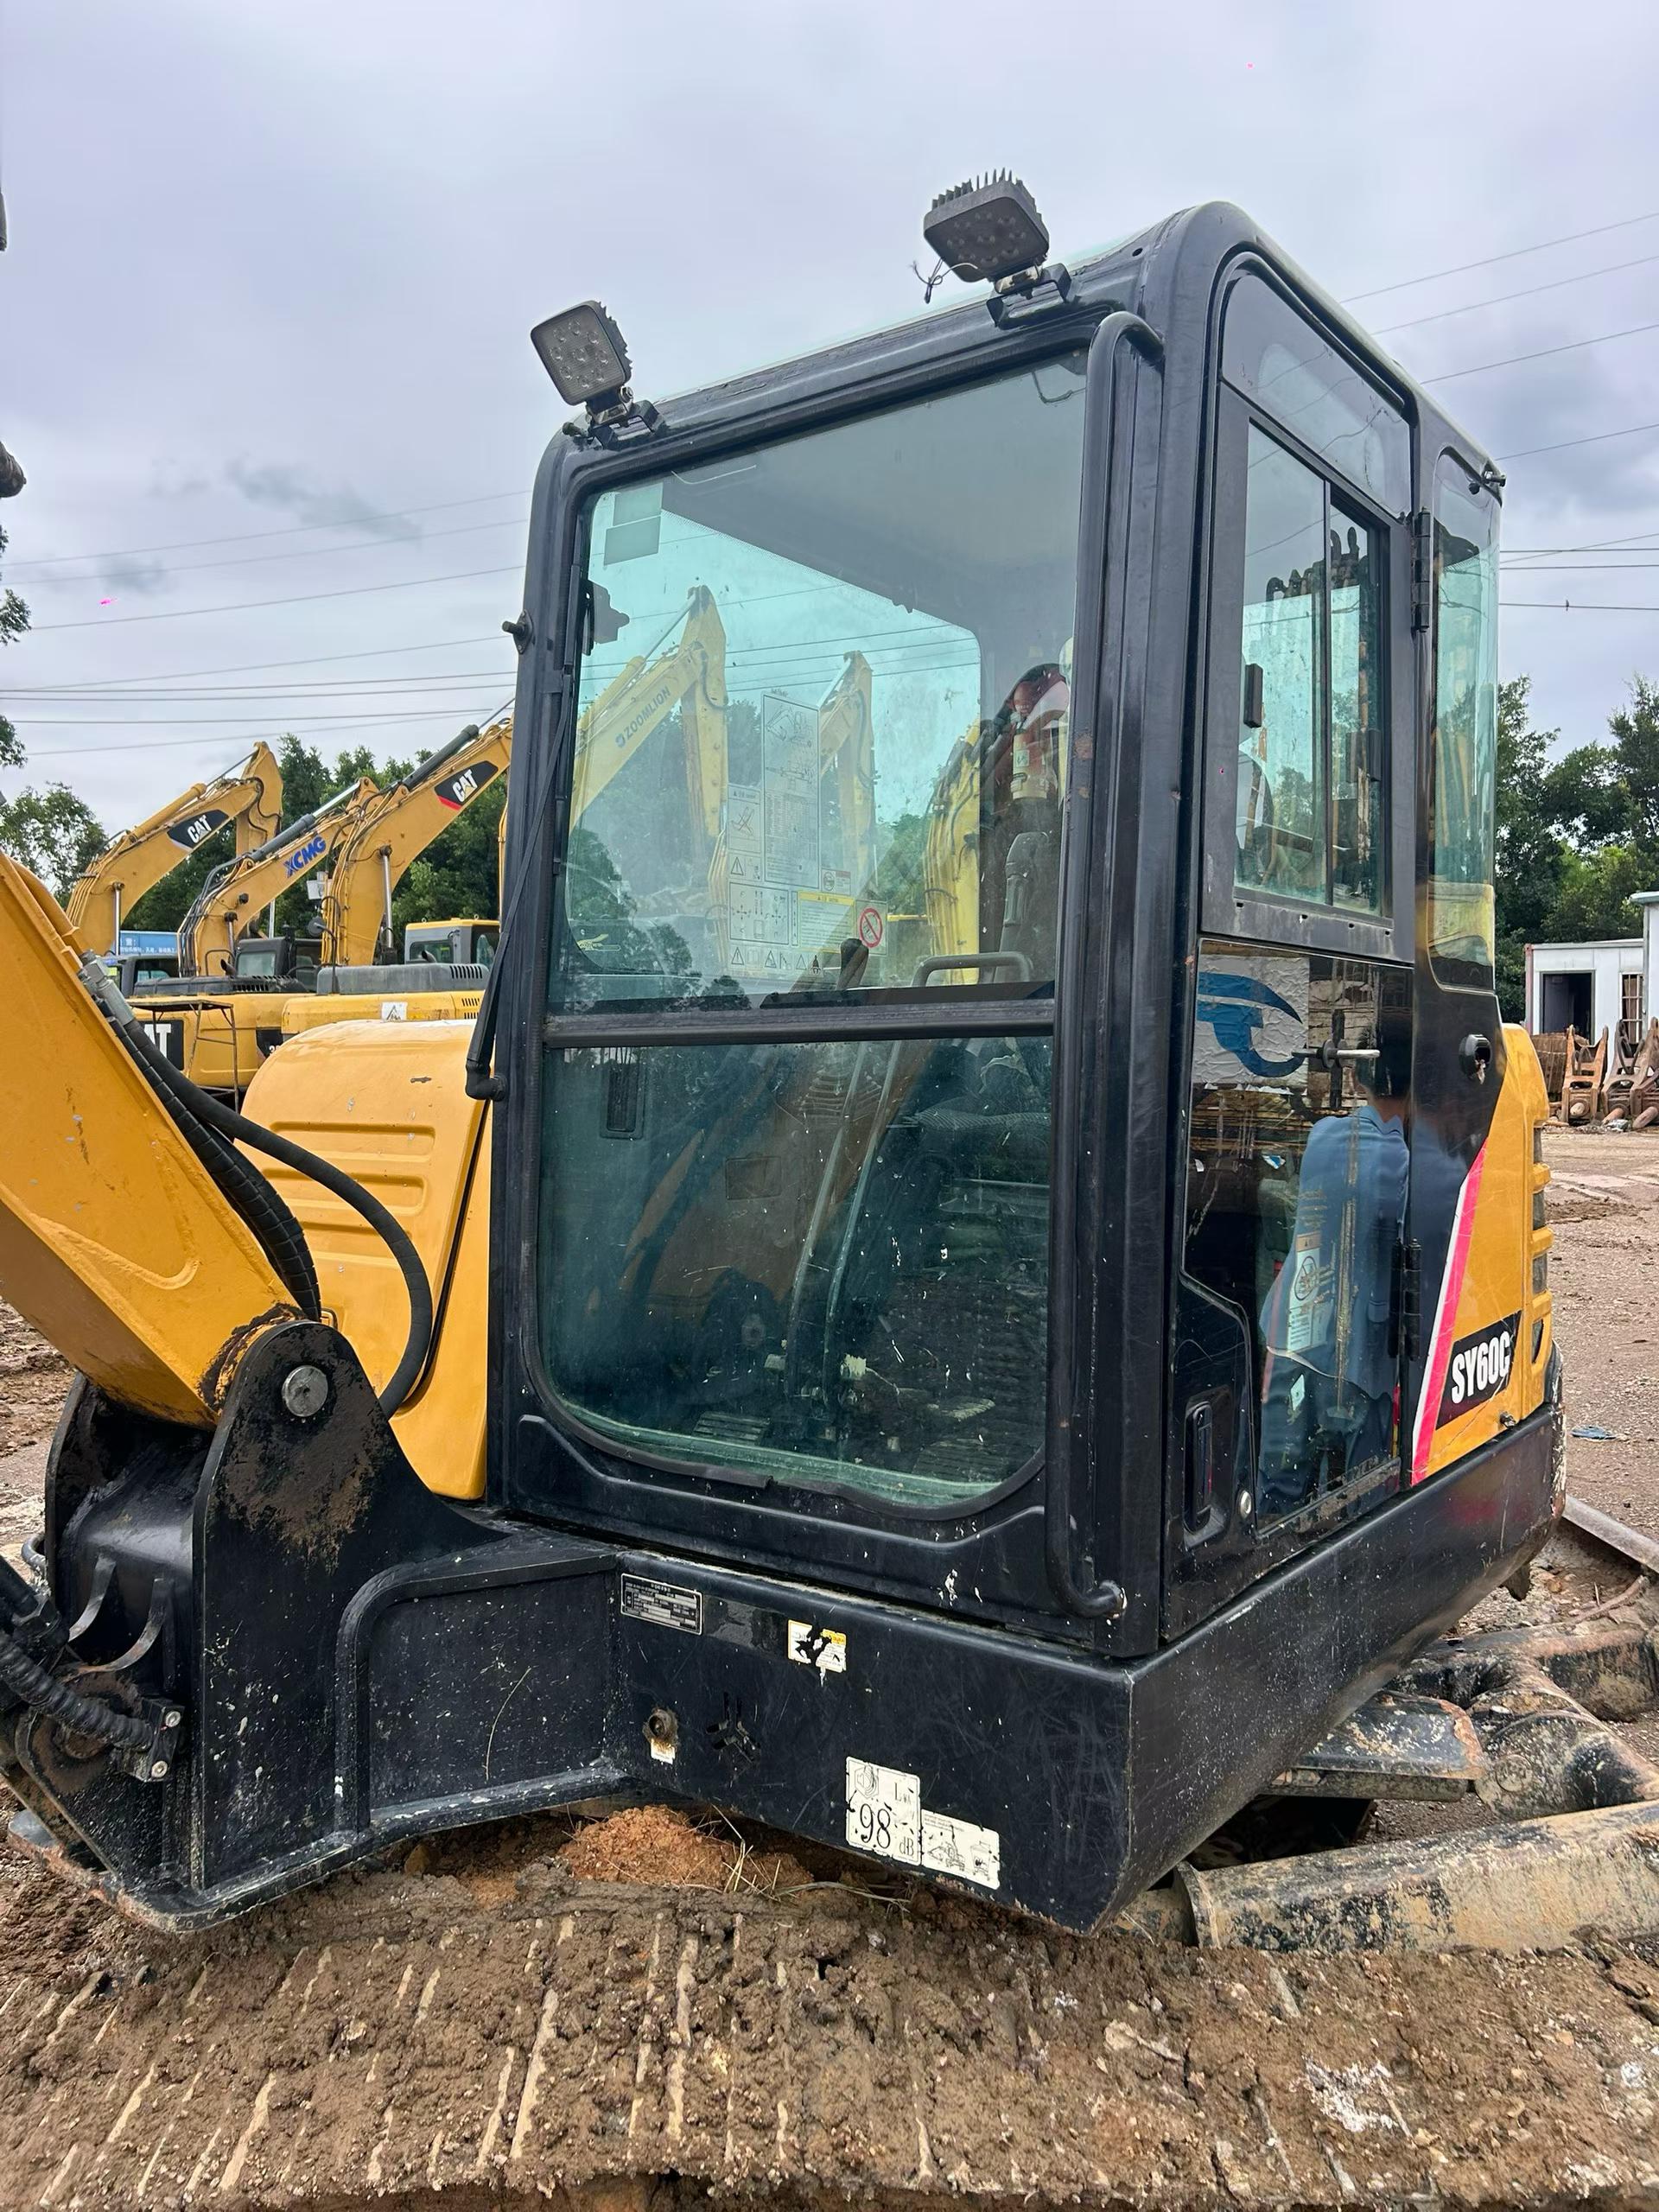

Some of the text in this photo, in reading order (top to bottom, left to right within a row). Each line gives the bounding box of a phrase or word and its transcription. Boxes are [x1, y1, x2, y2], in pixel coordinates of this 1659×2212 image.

[623, 685, 671, 741] ZOOMLION
[452, 769, 478, 802] CAT
[187, 814, 212, 843] CAT
[283, 836, 327, 878] XCMG
[1452, 1331, 1510, 1404] SY60C
[860, 1802, 891, 1849] 98
[899, 1836, 914, 1857] dB
